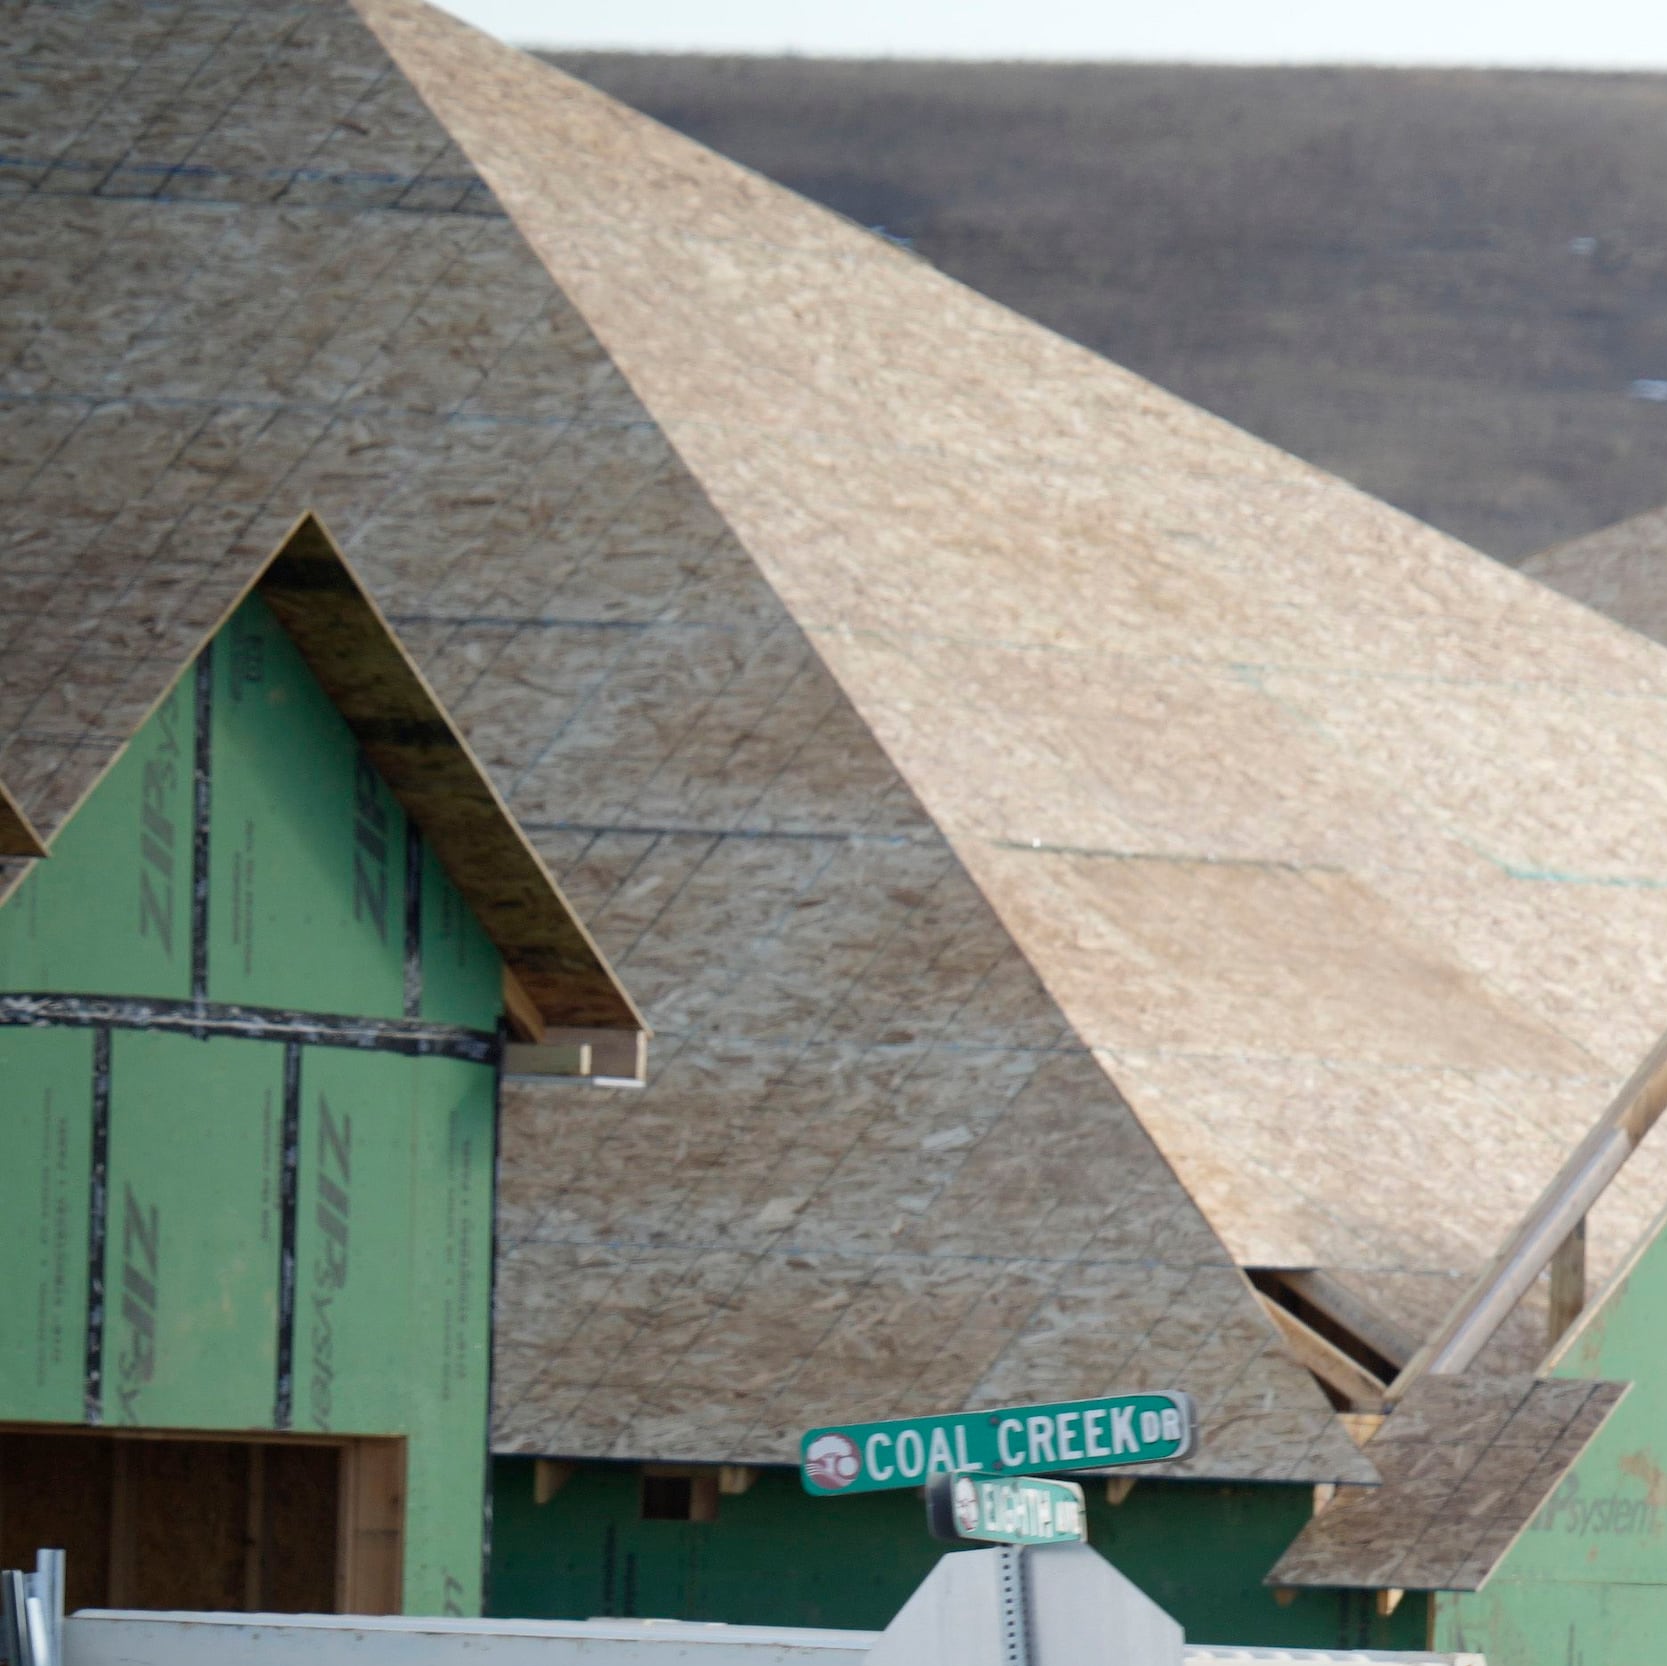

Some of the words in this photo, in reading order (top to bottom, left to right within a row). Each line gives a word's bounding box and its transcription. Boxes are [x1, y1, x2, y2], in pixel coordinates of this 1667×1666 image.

[865, 1424, 983, 1482] COAL
[997, 1404, 1142, 1467] CREEK
[1140, 1407, 1182, 1444] DR
